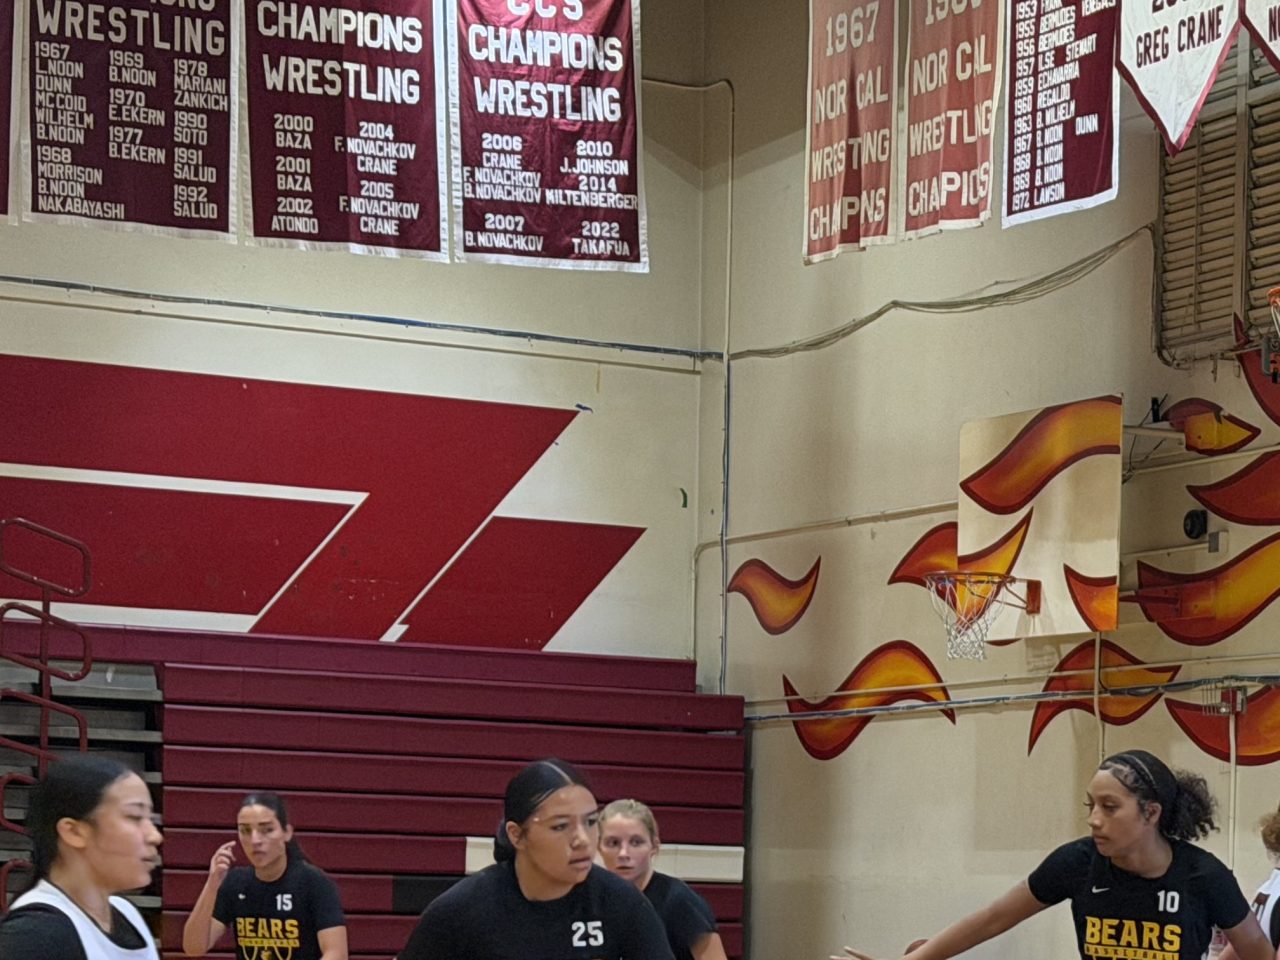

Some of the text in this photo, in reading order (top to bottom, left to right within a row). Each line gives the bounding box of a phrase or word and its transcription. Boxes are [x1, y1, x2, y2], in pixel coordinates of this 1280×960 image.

[1015, 1, 1037, 20] 1953
[37, 0, 225, 56] WRESTLING
[257, 0, 423, 54] CHAMPIONS
[826, 0, 880, 57] 1967
[1015, 18, 1035, 40] 1955
[1136, 4, 1223, 68] GREG CRANE
[36, 41, 70, 60] 1967
[468, 24, 624, 72] CHAMPIONS
[1015, 37, 1035, 59] 1956
[36, 58, 84, 78] L.NOON
[109, 50, 144, 69] 1969
[174, 59, 208, 77] 1978
[912, 33, 992, 96] NOR CAL
[1016, 57, 1035, 79] 1957
[36, 75, 72, 93] DUNN
[109, 67, 157, 87] B.NOON
[174, 75, 226, 94] MARIANI
[263, 54, 420, 105] WRESTLING
[109, 88, 146, 107] 1970
[174, 91, 228, 112] ZANKICH
[473, 77, 622, 122] WRESTLING
[815, 65, 889, 124] NOR CAL
[36, 108, 94, 130] WILHELM
[109, 105, 166, 127] E.EKERN
[174, 111, 208, 129] 1990
[274, 114, 313, 132] 2000
[37, 125, 85, 145] B.NOON
[109, 126, 143, 145] 1977
[174, 129, 208, 146] SOTO
[359, 122, 394, 140] 2004
[275, 132, 313, 150] BAZA
[481, 133, 522, 151] 2006
[576, 139, 613, 157] 2010
[1014, 132, 1032, 155] 1967
[38, 145, 72, 163] 1968
[109, 143, 166, 164] B.EKERN
[174, 147, 203, 165] 1991
[482, 152, 522, 169] CRANE
[38, 163, 102, 185] MORRISON
[174, 164, 217, 184] SALUD
[276, 155, 311, 174] 2001
[357, 156, 397, 176] CRANE
[38, 179, 85, 198] B.NOON
[276, 174, 313, 193] BAZA
[360, 181, 394, 199] 2005
[579, 176, 617, 192] 2014
[174, 185, 208, 203] 1992
[545, 189, 638, 210] MILTENBERGER
[1012, 191, 1030, 212] 1972
[38, 195, 125, 219] NAKABAYASHI
[174, 201, 218, 220] SALUD
[276, 196, 313, 215] 2002
[271, 215, 319, 234] ATONDO
[360, 217, 399, 236] CRANE
[484, 213, 525, 233] 2007
[581, 221, 620, 238] 2022
[571, 237, 630, 256] TAKAFUA
[276, 893, 293, 911] 15
[1157, 890, 1180, 913] 10
[236, 917, 300, 939] BEARS
[572, 920, 604, 947] 25
[1085, 916, 1182, 952] BEARS
